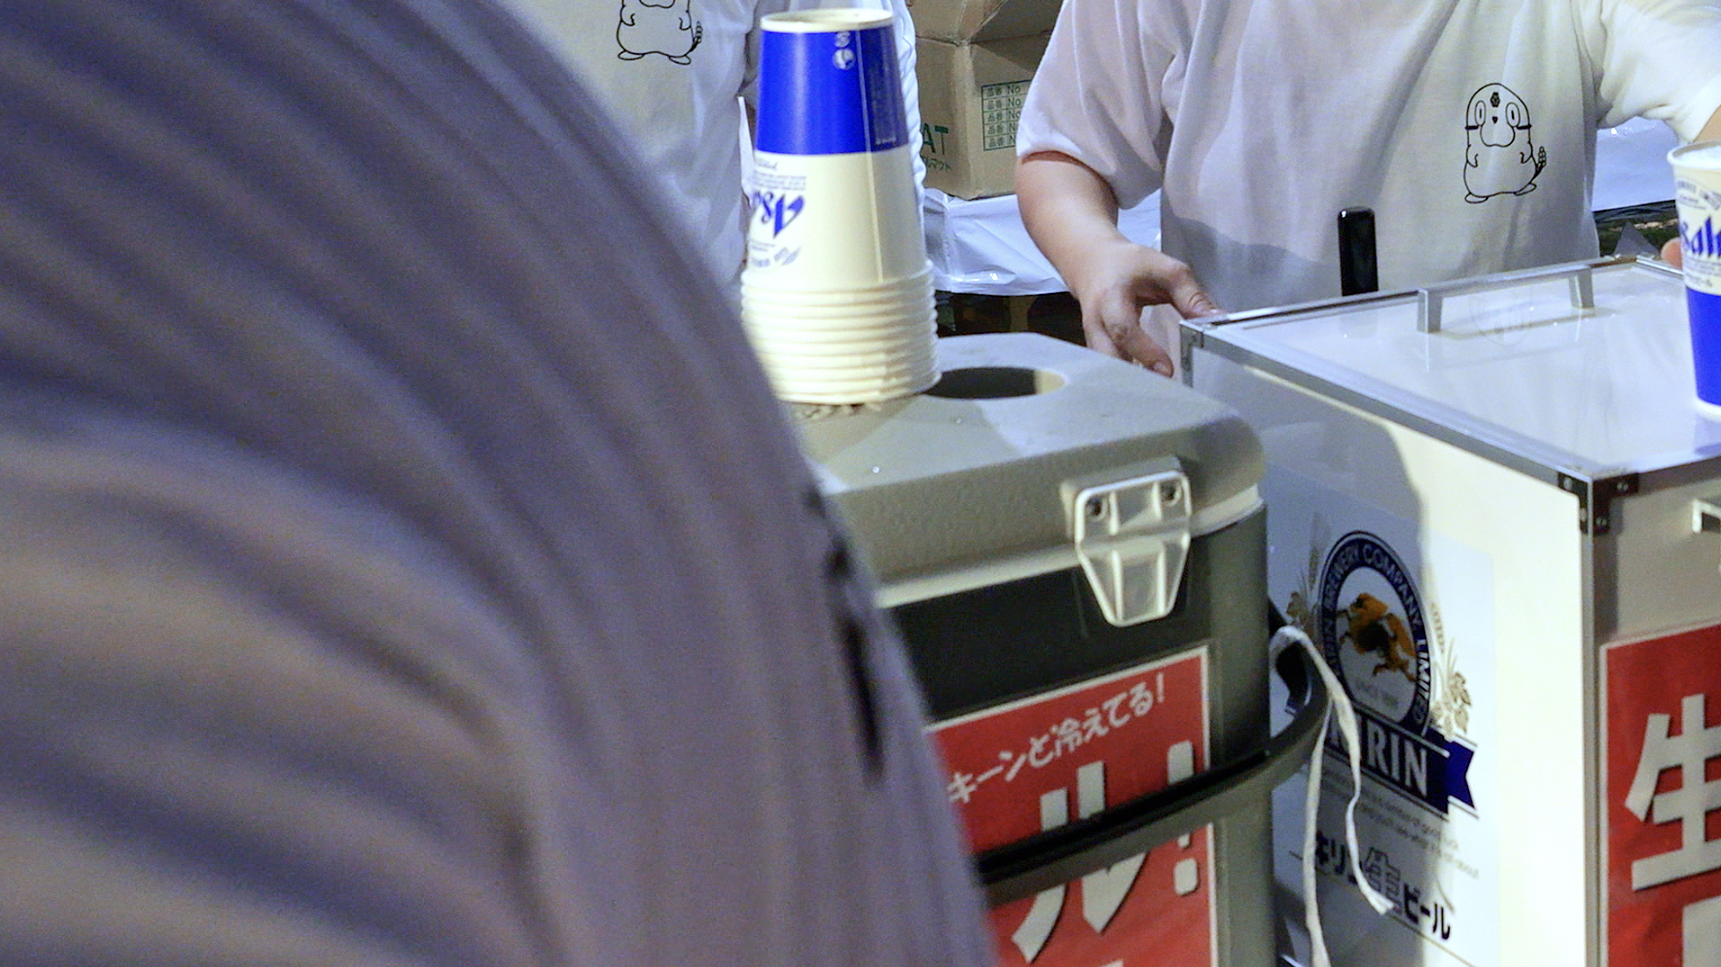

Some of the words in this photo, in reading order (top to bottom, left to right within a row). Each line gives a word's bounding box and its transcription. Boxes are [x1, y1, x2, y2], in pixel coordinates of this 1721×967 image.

[948, 672, 1165, 804] キーンと冷えてる!
